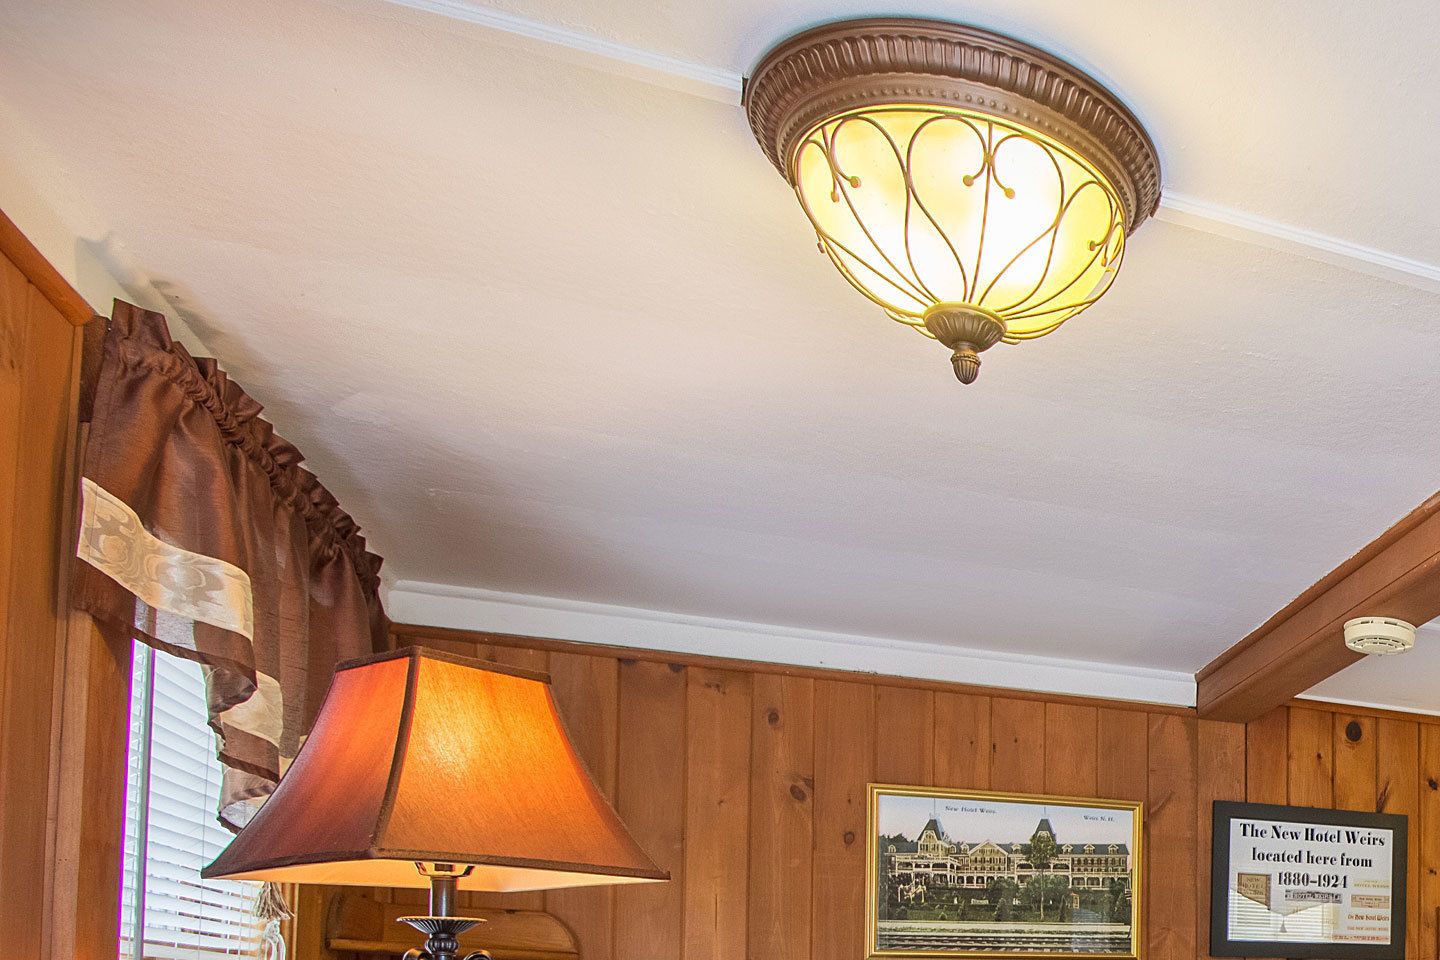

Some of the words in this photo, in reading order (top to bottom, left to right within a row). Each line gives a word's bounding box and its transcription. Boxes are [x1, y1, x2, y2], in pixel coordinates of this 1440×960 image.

[1239, 822, 1267, 839] The
[1270, 825, 1302, 841] New
[1304, 827, 1342, 843] Hotel
[1344, 830, 1386, 847] Weirs
[1252, 847, 1302, 864] located
[1306, 850, 1338, 866] here
[1340, 853, 1373, 868] from
